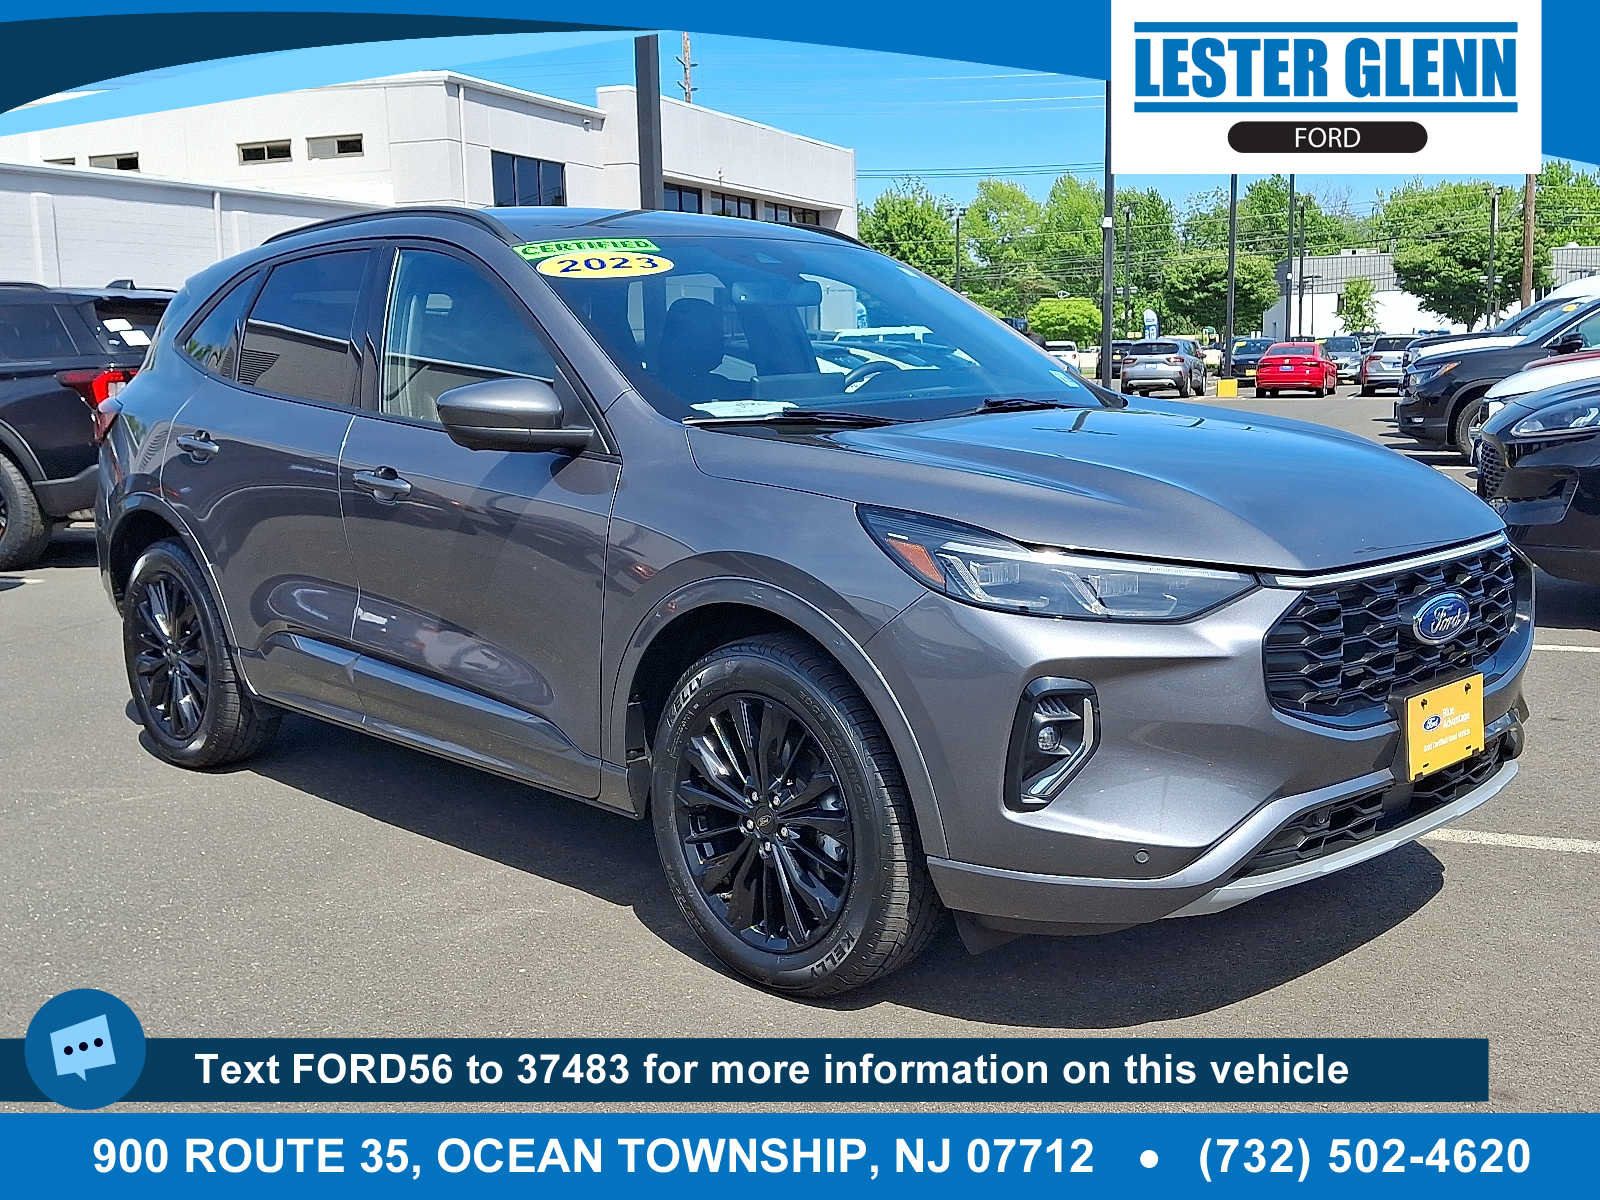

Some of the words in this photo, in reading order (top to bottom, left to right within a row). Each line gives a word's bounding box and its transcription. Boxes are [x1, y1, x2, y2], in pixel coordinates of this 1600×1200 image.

[521, 240, 649, 255] CERTIFIED
[557, 257, 659, 273] 2023
[1430, 605, 1462, 634] Ford
[666, 673, 704, 729] KELLY
[809, 929, 856, 978] KELLY
